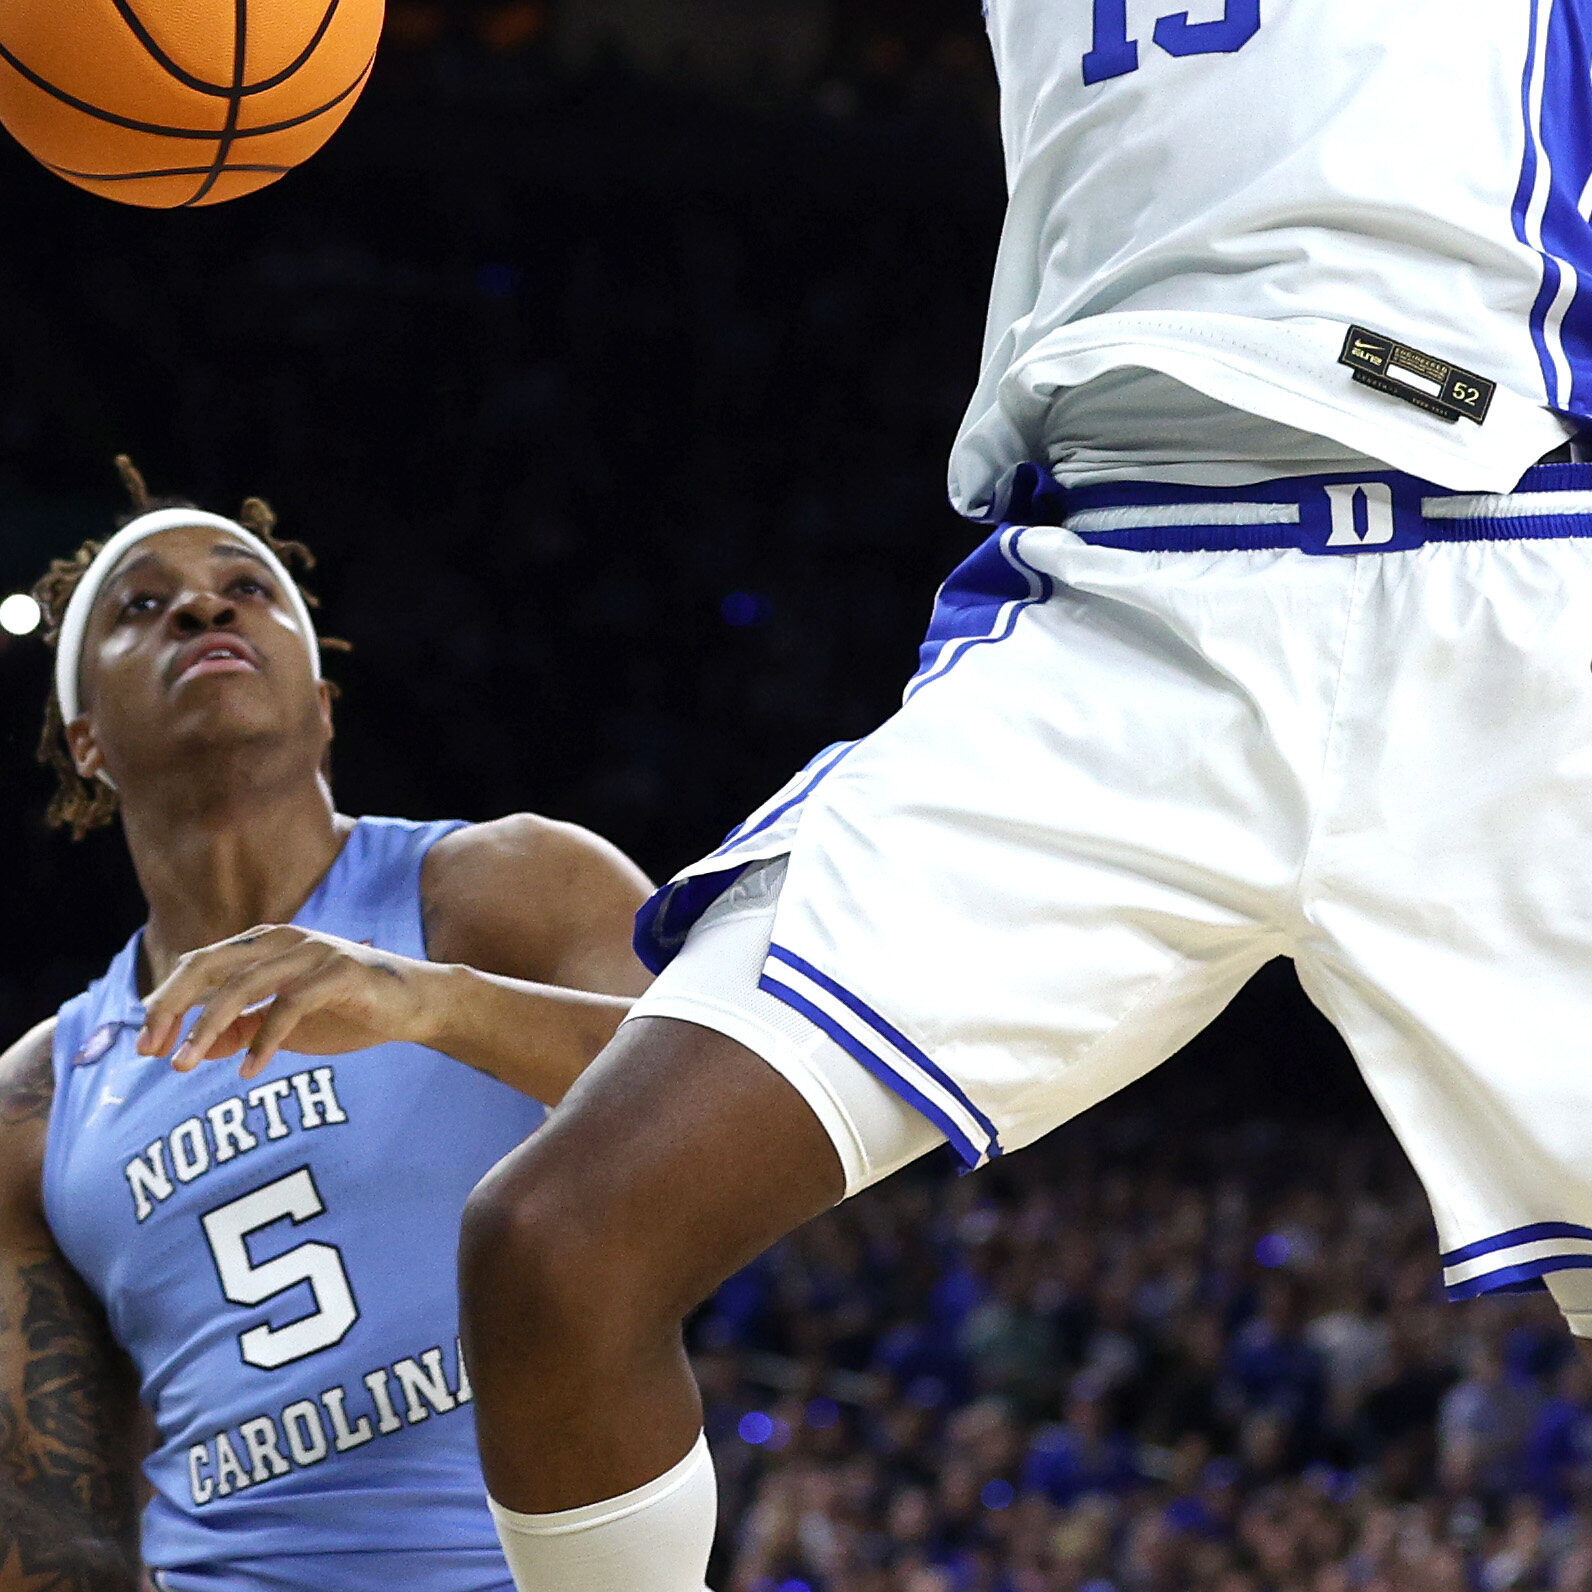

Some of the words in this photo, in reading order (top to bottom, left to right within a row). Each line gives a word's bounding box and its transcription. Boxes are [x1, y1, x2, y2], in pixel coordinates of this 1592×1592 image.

[1452, 381, 1480, 407] 52
[1323, 481, 1395, 547] D
[124, 1065, 348, 1224] NORTH
[200, 1163, 359, 1370] 5
